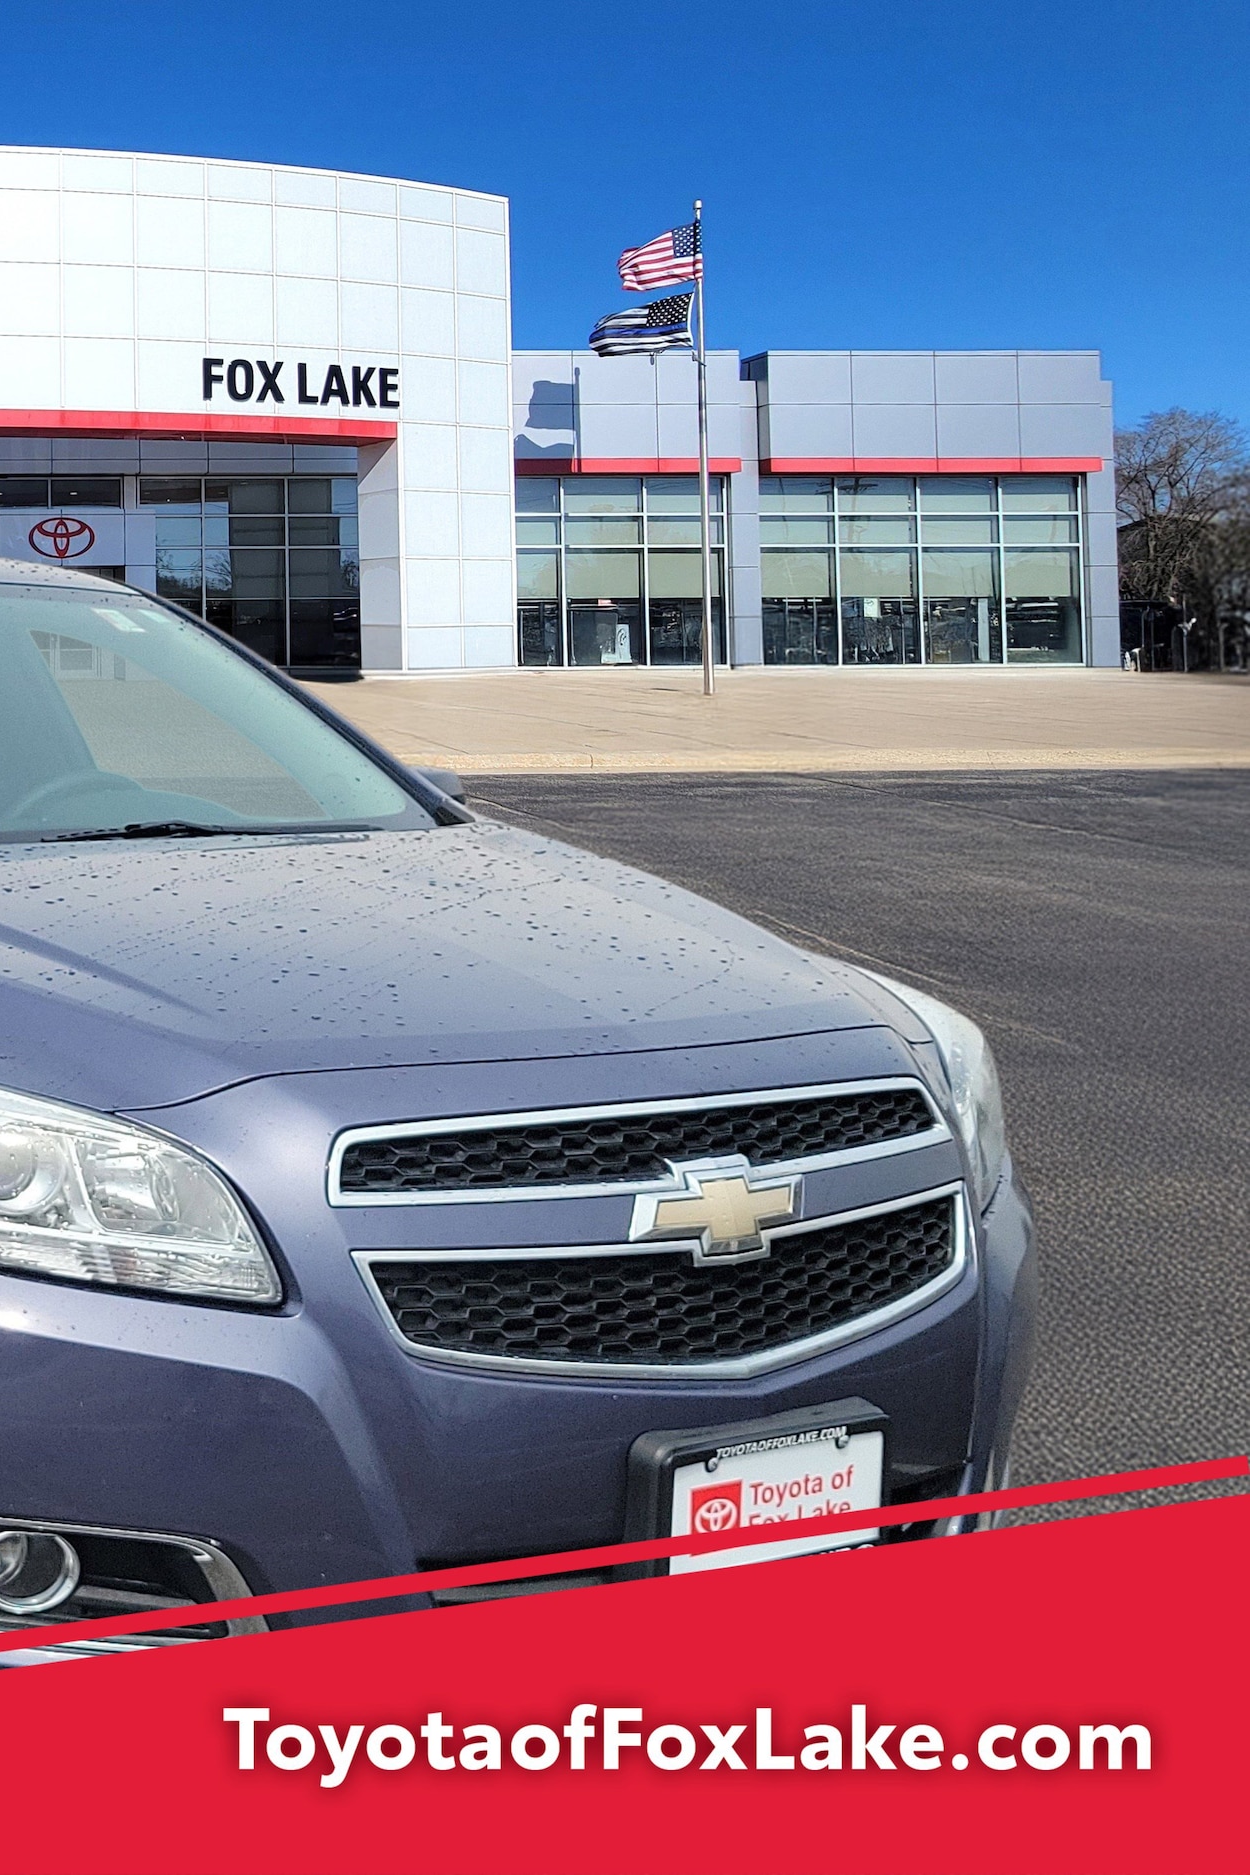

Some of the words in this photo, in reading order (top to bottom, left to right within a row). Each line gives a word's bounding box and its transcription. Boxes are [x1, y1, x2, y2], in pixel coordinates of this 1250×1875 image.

[202, 357, 285, 403] FOX
[296, 362, 401, 409] LAKE
[716, 1425, 848, 1459] TOYOTAOFFOXLAKE.COM
[749, 1474, 823, 1507] Toyota
[831, 1465, 854, 1490] of
